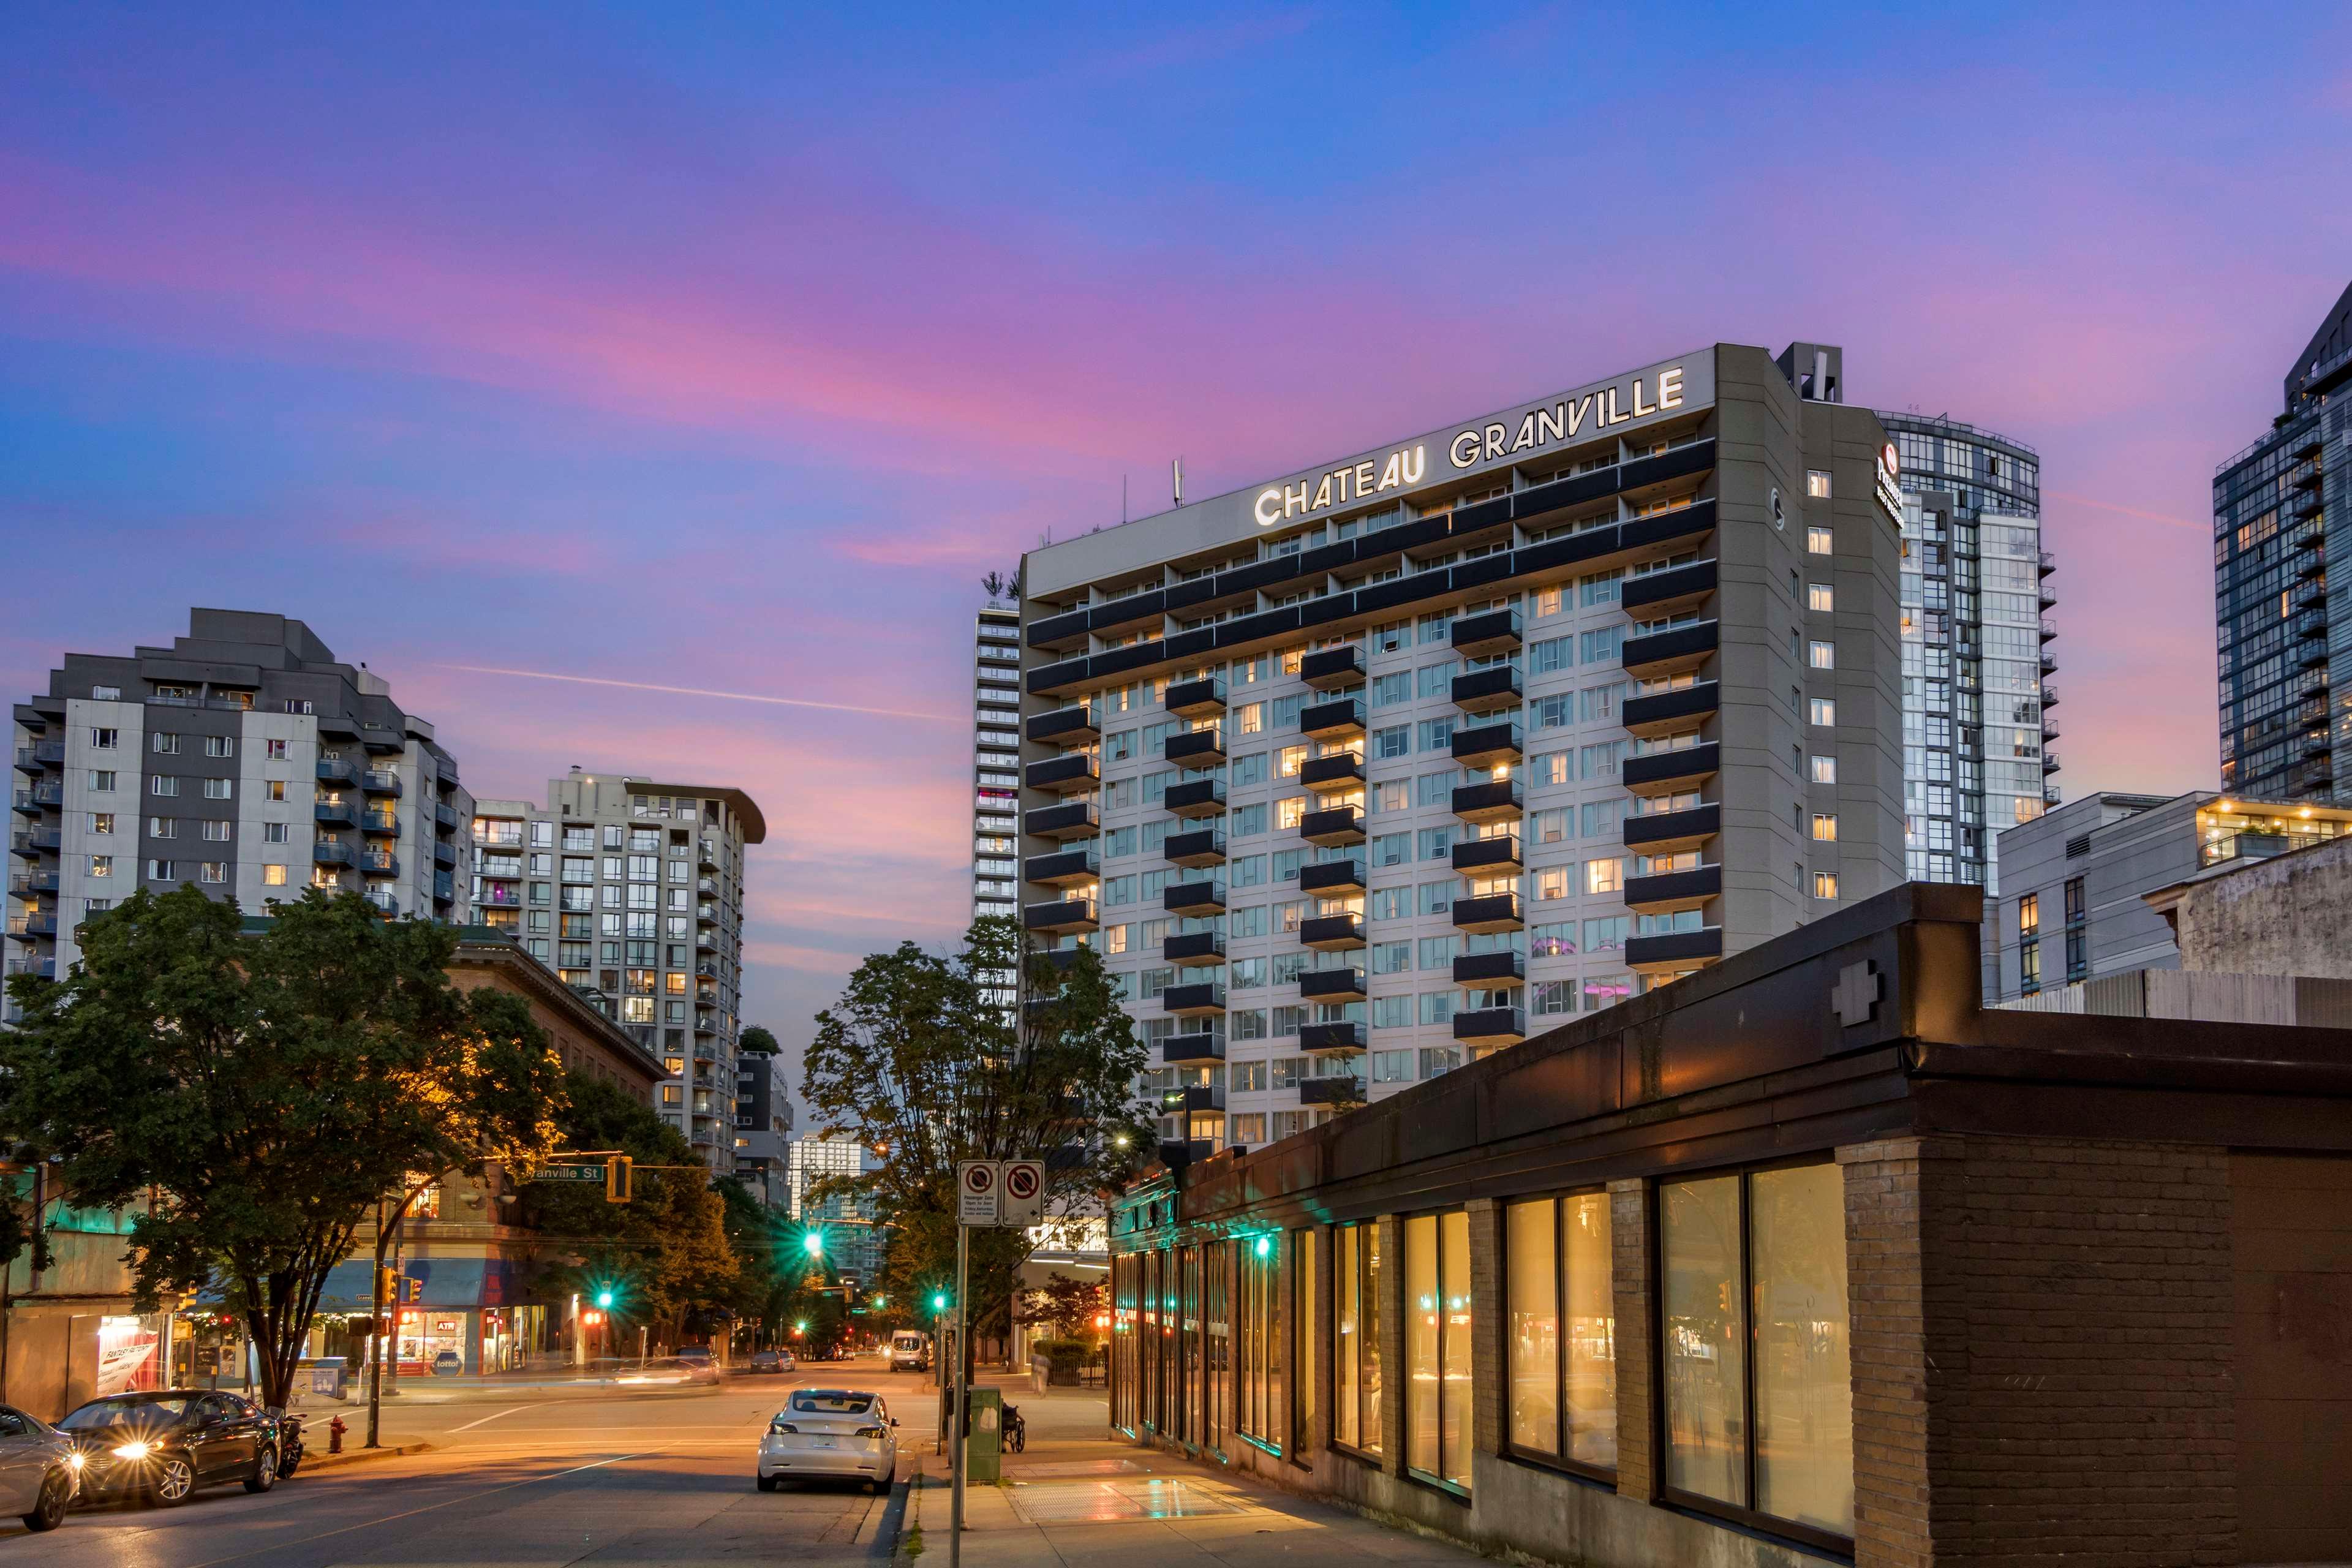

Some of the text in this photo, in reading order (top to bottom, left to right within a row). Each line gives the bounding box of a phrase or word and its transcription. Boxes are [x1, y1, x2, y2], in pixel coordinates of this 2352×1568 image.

[1254, 366, 1683, 526] CHATEAU GRANVILLE
[583, 1167, 598, 1178] St
[106, 1349, 129, 1359] FANTASY
